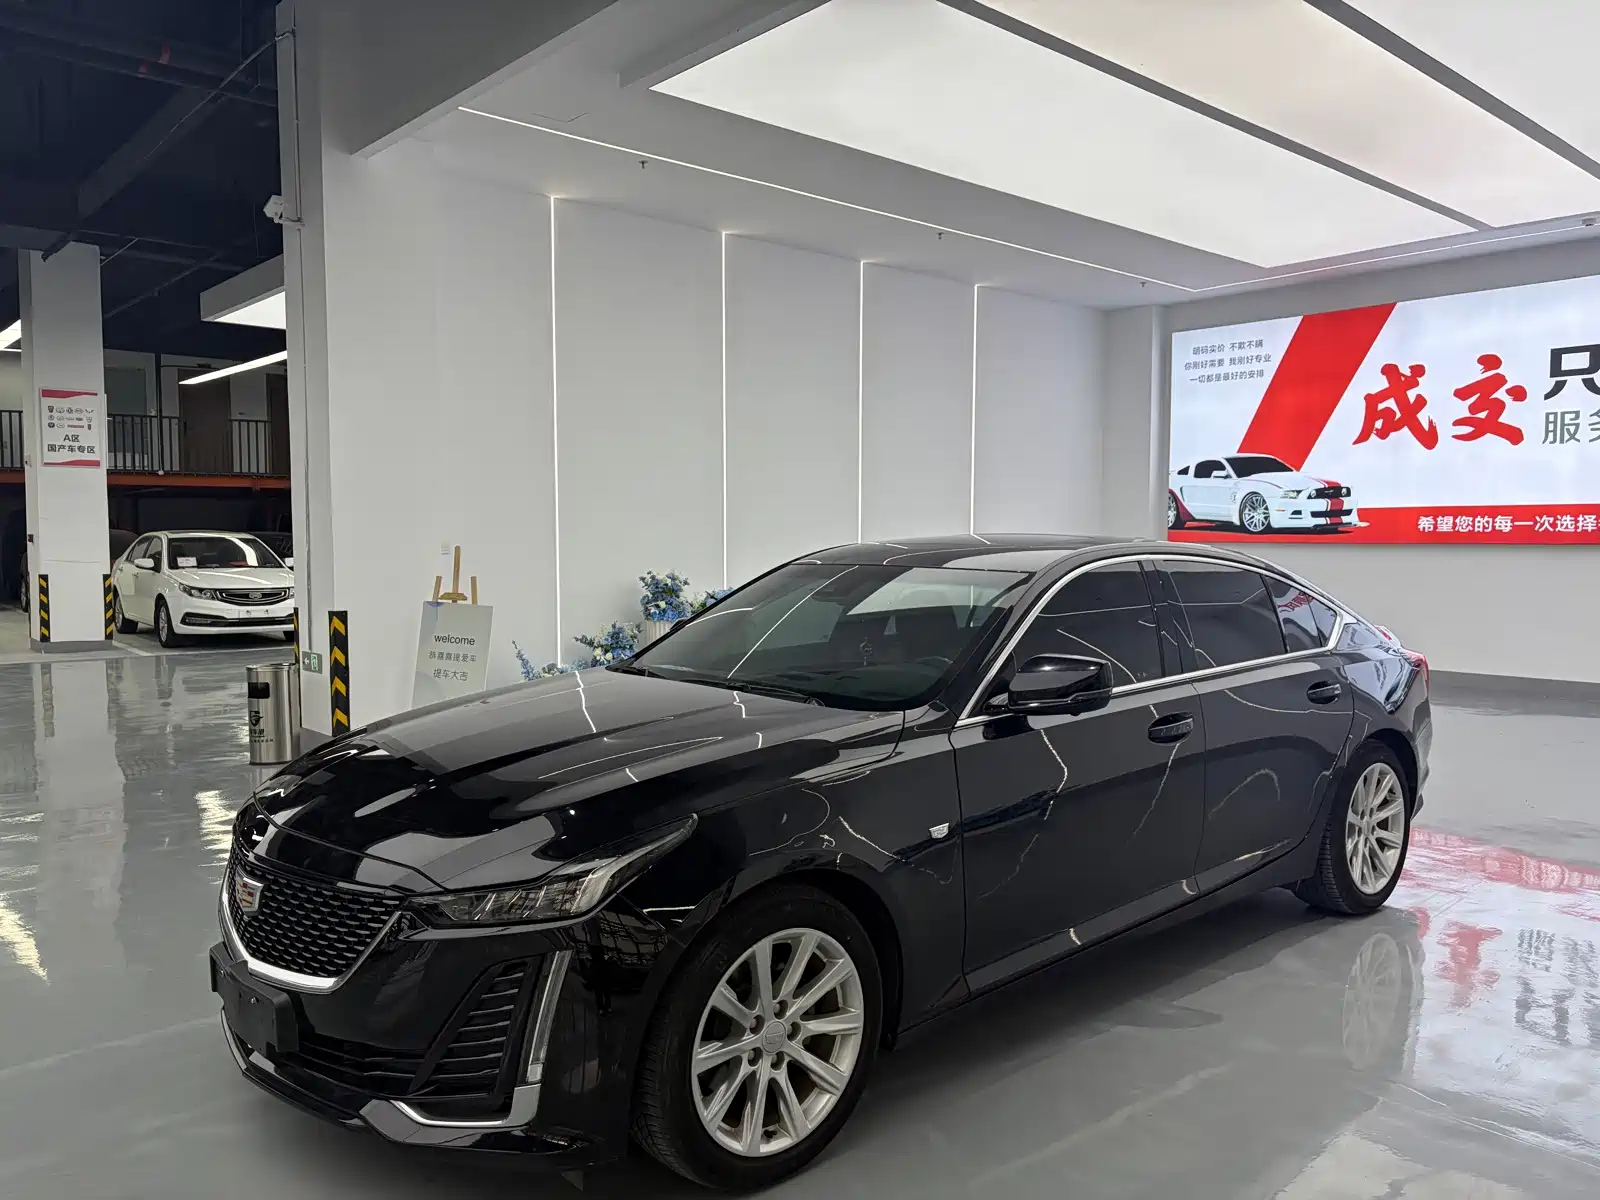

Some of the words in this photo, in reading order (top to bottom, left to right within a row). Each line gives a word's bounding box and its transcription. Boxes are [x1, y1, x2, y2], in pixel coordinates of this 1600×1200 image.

[1193, 344, 1225, 355] 明码实价
[1184, 358, 1225, 371] 你刚好需要
[1229, 354, 1272, 366] 我刚好专业
[1190, 369, 1264, 383] 一切都是最好的安排
[1352, 354, 1528, 450] 成交
[63, 434, 80, 442] A区
[47, 443, 96, 454] 国产车专区
[1418, 515, 1600, 532] 希望您的每一次选择
[434, 634, 476, 646] welcome
[433, 668, 469, 681] 提车大吉
